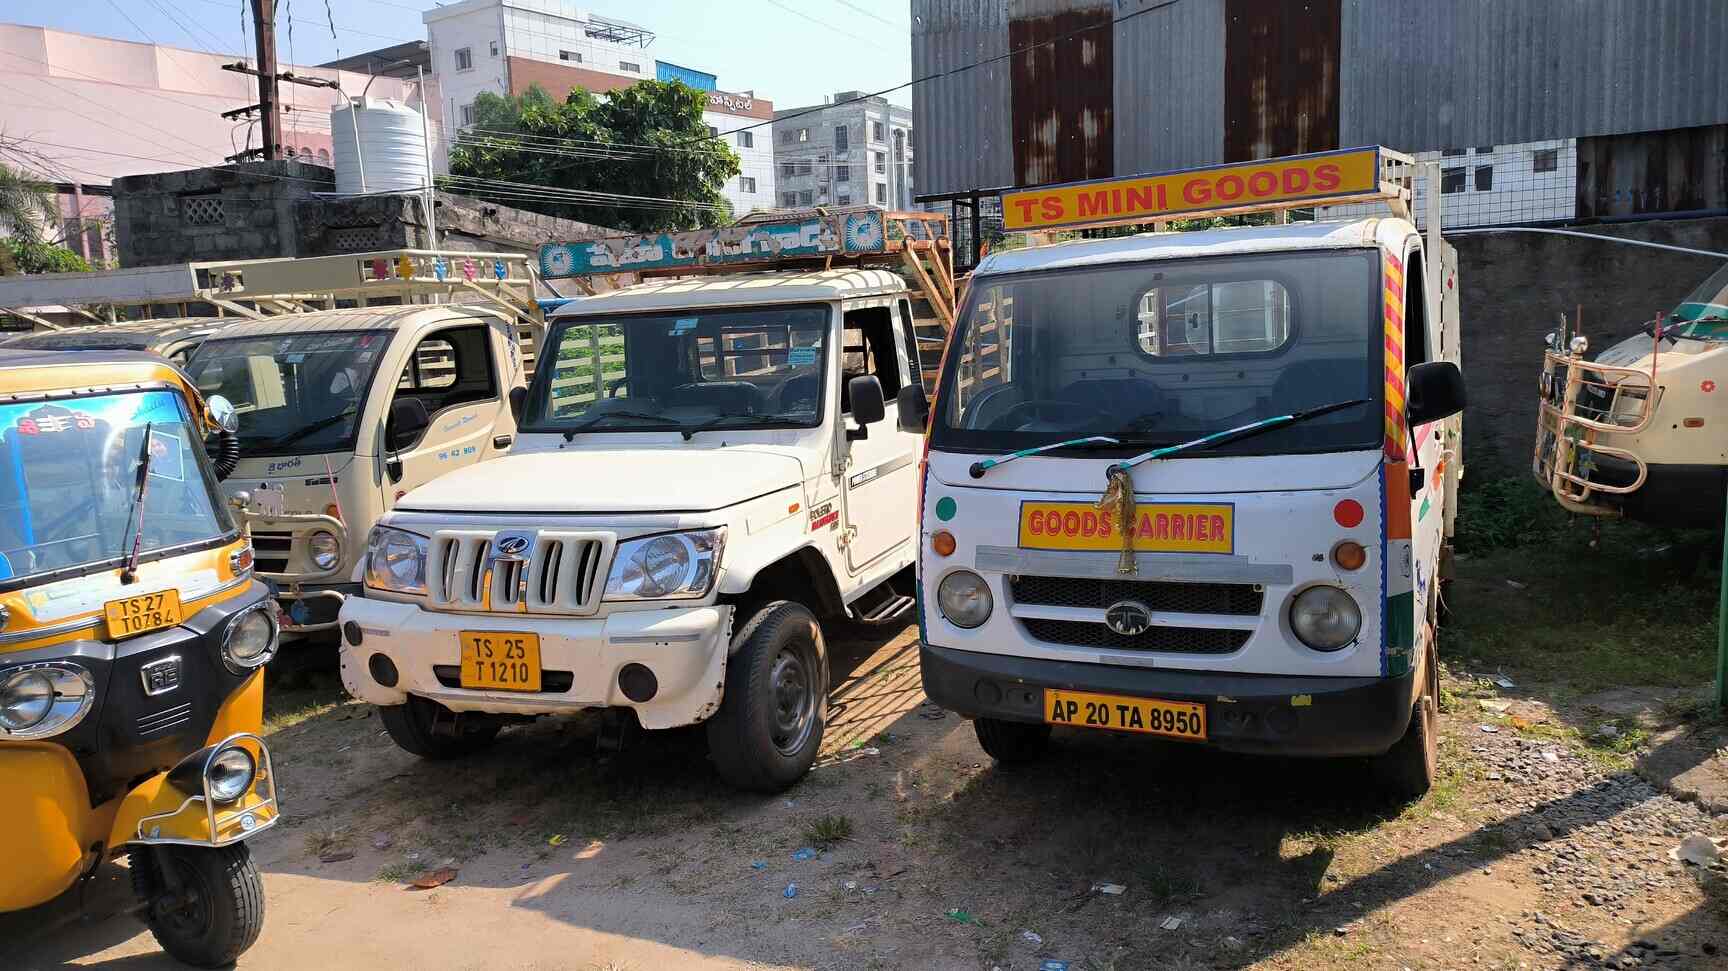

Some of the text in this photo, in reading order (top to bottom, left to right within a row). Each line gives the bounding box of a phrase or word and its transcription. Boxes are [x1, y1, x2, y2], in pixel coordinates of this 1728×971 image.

[1015, 164, 1342, 223] TS MINI GOODS
[1028, 510, 1113, 538] GOODS
[120, 594, 164, 617] TS 27
[473, 638, 525, 659] TS 25
[1052, 699, 1201, 735] AP 20 TA 8950
